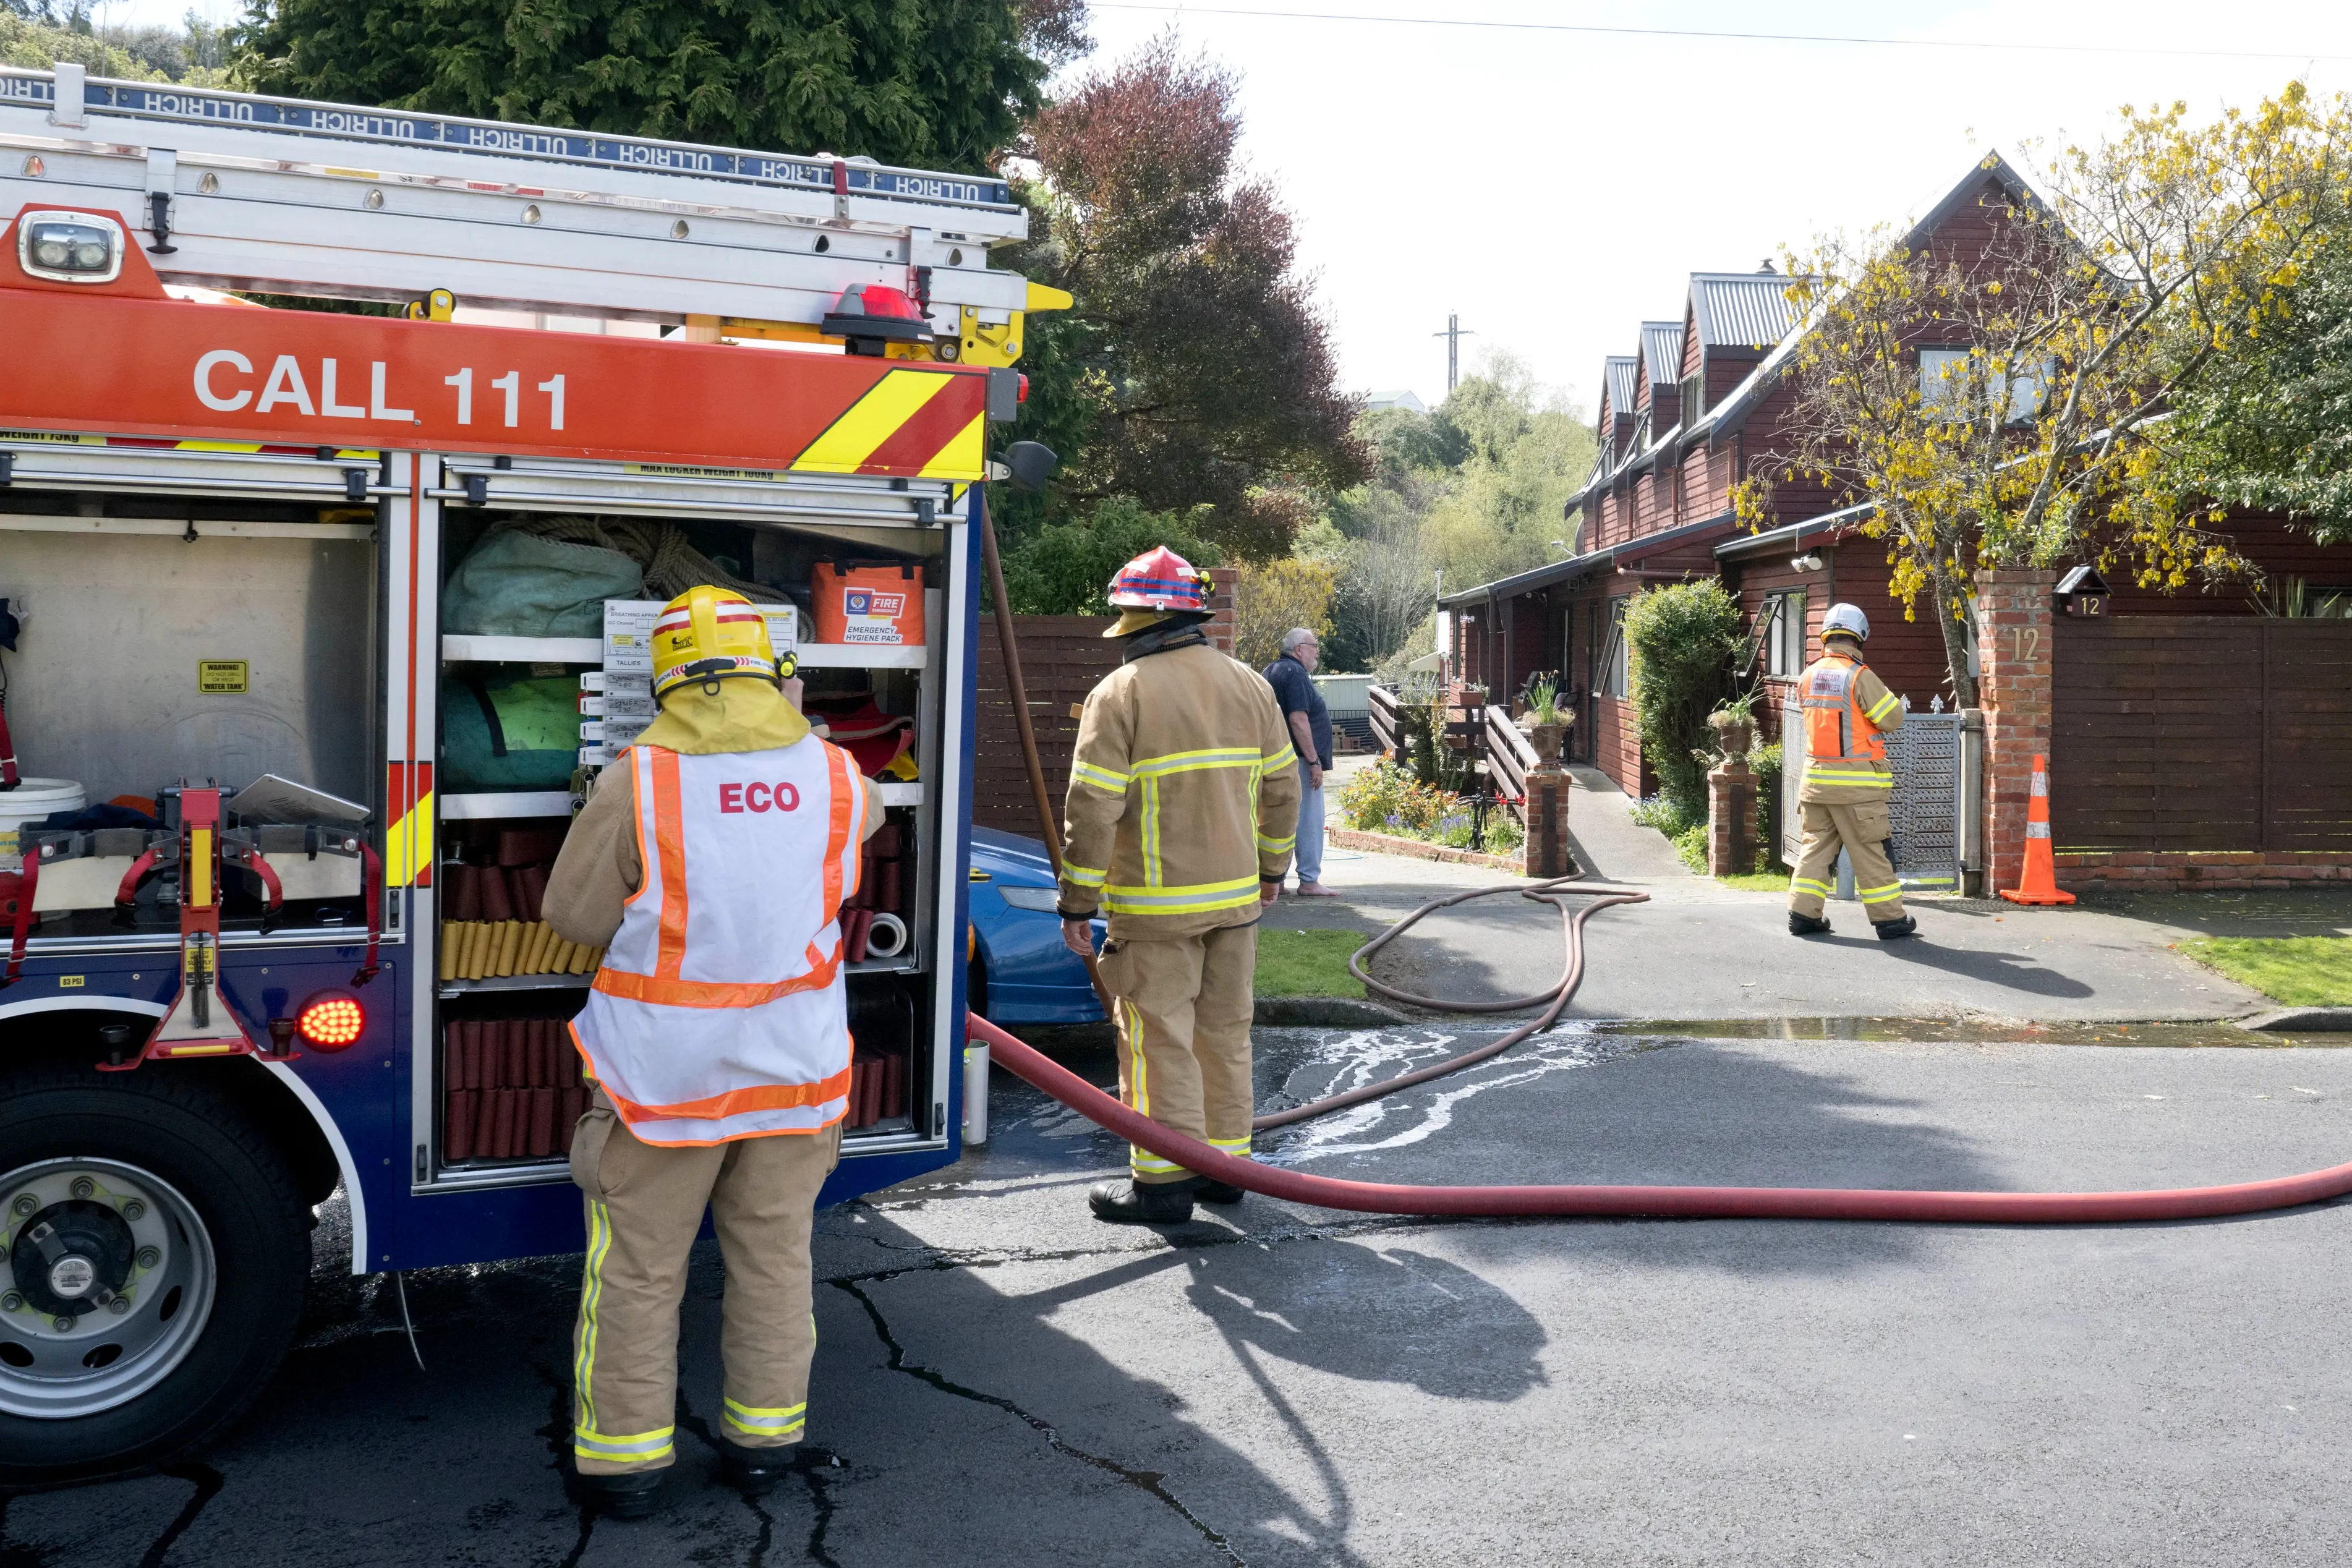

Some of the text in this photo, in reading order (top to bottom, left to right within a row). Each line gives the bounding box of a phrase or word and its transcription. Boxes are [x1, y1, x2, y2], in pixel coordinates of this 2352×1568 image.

[145, 93, 253, 122] ULLRICH
[311, 111, 415, 140] ULLRICH
[469, 128, 568, 156] ULLRICH
[619, 144, 712, 171] ULLRICH
[761, 161, 850, 187] LLRICH
[895, 176, 979, 202] ULLRICH
[194, 349, 566, 431] CALL 111
[640, 465, 663, 474] MAX
[665, 466, 701, 475] LOCKER
[704, 468, 740, 477] WEIGHT
[872, 598, 900, 608] FIRE
[2081, 597, 2100, 615] 12
[848, 626, 895, 634] EMERGENCY
[2013, 626, 2040, 662] 12
[1812, 682, 1841, 692] COMMANDER
[1815, 673, 1841, 682] ASSISTANT
[719, 782, 801, 814] ECO
